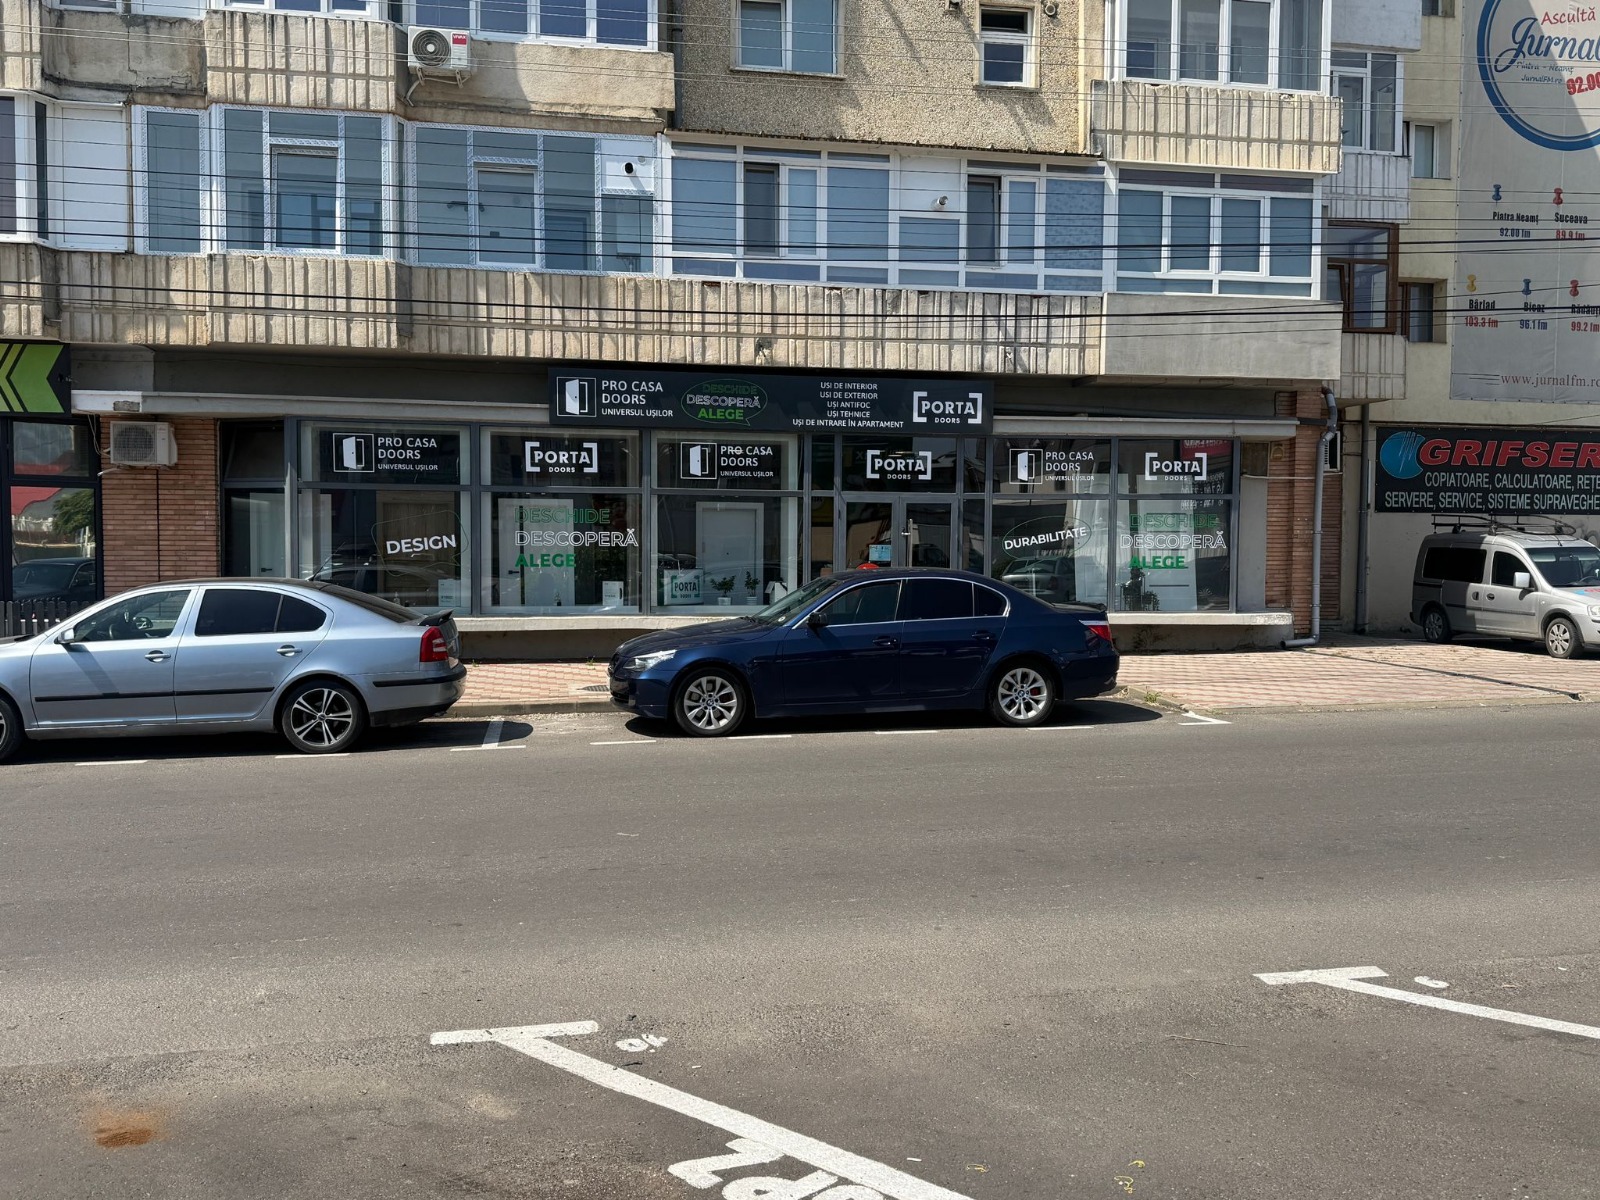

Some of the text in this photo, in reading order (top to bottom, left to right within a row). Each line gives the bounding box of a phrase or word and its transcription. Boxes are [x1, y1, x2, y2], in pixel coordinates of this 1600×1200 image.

[1541, 7, 1596, 25] Ascultă
[1493, 211, 1515, 221] Piatra
[1554, 212, 1588, 224] Suceava
[1521, 229, 1531, 238] fm
[1520, 320, 1548, 330] 96.1 fm
[1571, 321, 1600, 332] 99.2 fm
[602, 380, 663, 392] PRO CASA
[702, 382, 758, 395] DESCHIDE
[602, 393, 646, 405] DOORS
[686, 394, 761, 408] DESCOPERĂ
[844, 392, 878, 400] EXTERIOR
[602, 408, 645, 417] UNIVERSUL
[921, 401, 975, 414] PORTA
[698, 408, 744, 420] ALEGE
[817, 419, 846, 427] INTRARE
[857, 420, 904, 428] APARTAMENT
[378, 437, 437, 448] PRO CASA
[378, 449, 421, 459] DOORS
[534, 450, 590, 464] PORTA
[720, 446, 773, 456] PRO CASA
[1045, 452, 1094, 460] PRO CASA
[720, 457, 758, 466] DOORS
[874, 458, 925, 472] PORTA
[1045, 462, 1080, 472] DOORS
[1152, 460, 1200, 472] PORTA
[1424, 472, 1492, 490] COPIATOARE,
[1494, 473, 1574, 491] CALCULATOARE,
[1385, 491, 1436, 510] SERVERE,
[1438, 492, 1485, 511] SERVICE,
[1488, 494, 1531, 510] SISTEME
[514, 508, 610, 524] DESCHIDE
[1130, 514, 1218, 528] DESCHIDE
[514, 528, 639, 546] DESCOPERĂ
[1004, 527, 1087, 550] DURABILITATE
[1120, 531, 1226, 548] DESCOPERĂ
[386, 534, 457, 554] DESIGN
[514, 554, 576, 568] ALEGE
[1130, 556, 1186, 569] ALEGE
[674, 582, 697, 592] PORTA
